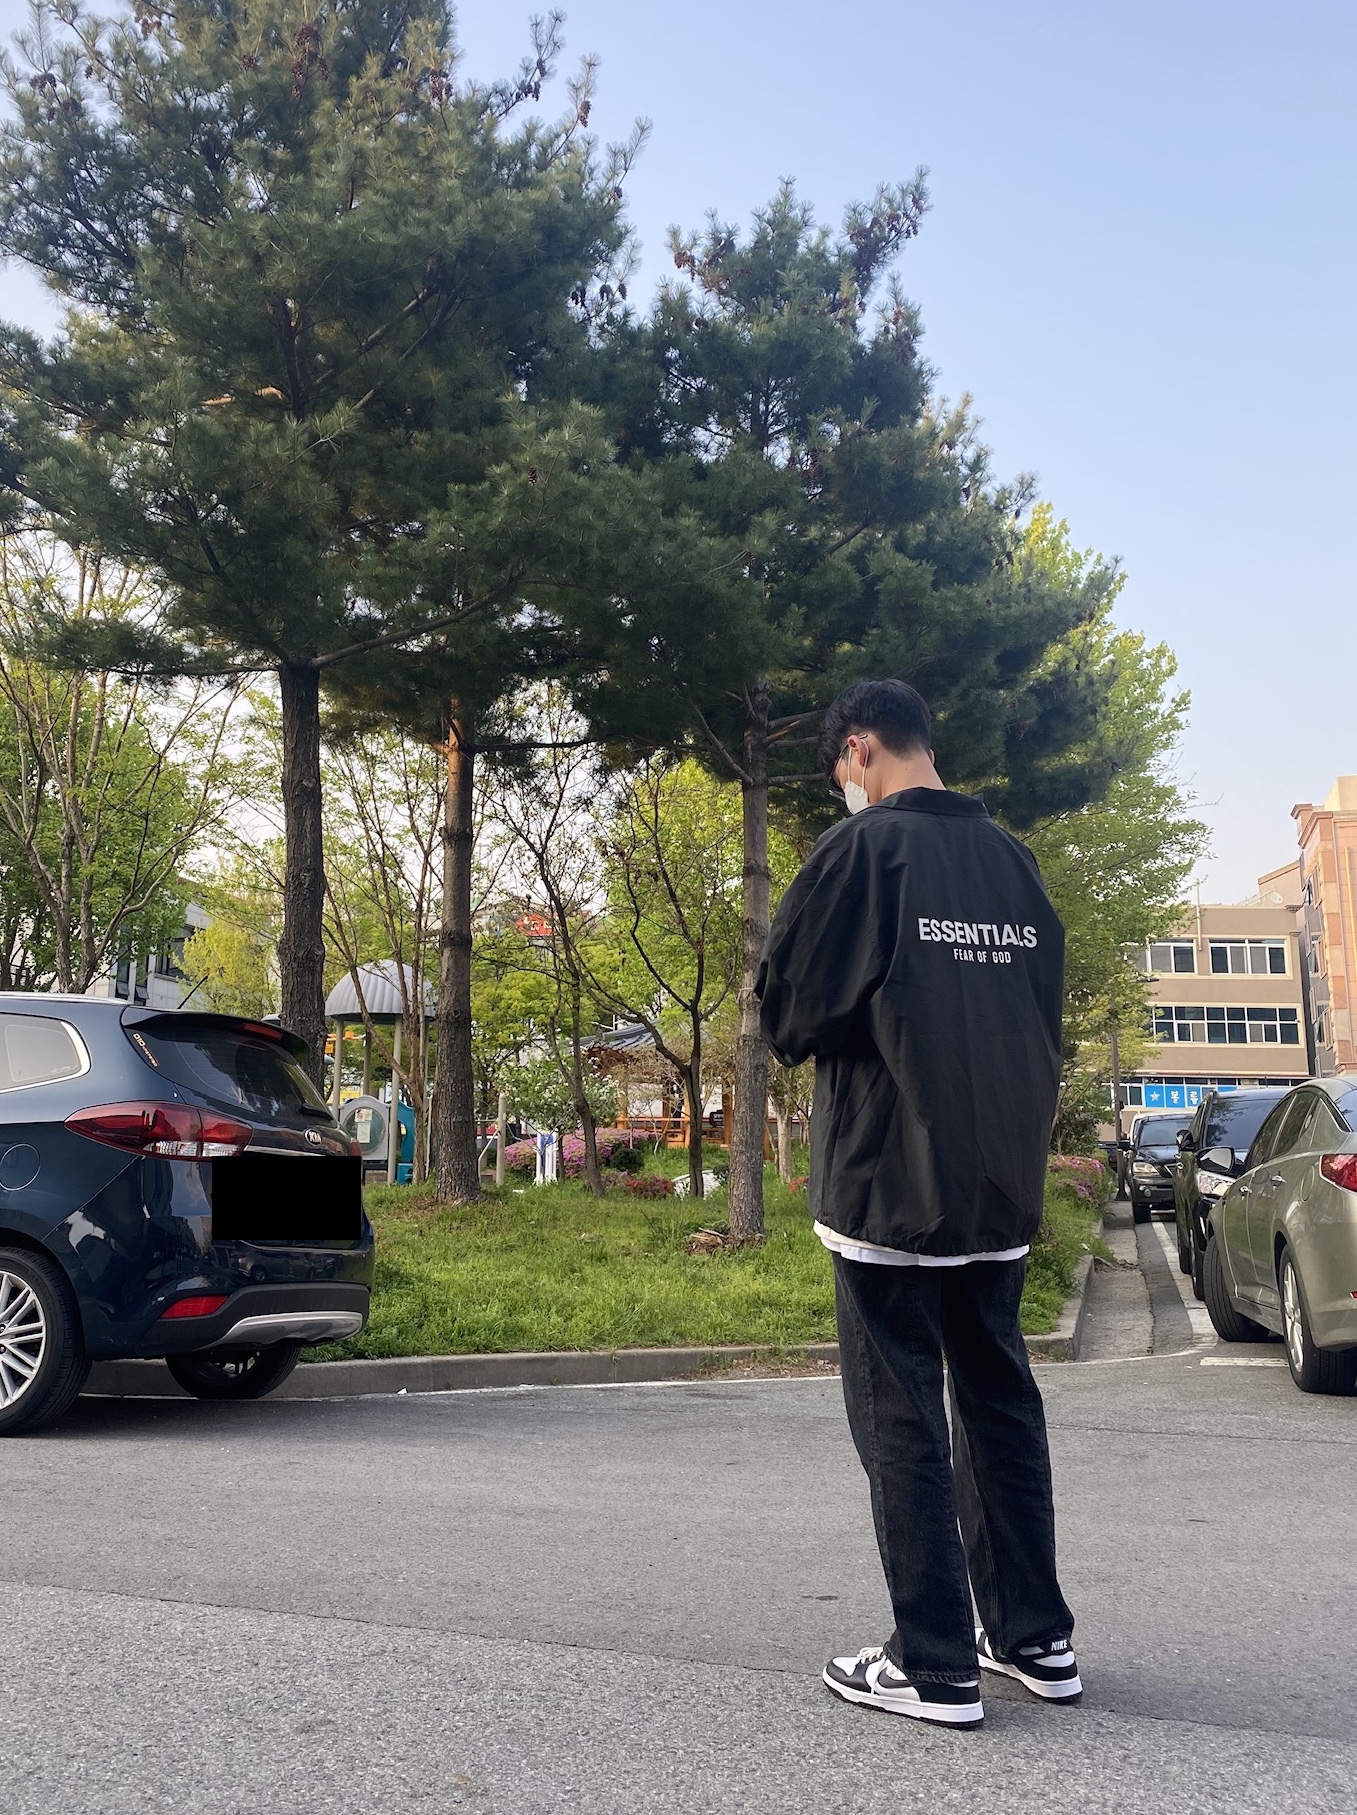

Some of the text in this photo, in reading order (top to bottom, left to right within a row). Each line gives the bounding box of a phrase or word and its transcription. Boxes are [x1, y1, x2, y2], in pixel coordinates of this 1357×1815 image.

[953, 949, 1012, 964] FEAR OF GOD
[307, 1130, 322, 1144] KIA
[1050, 1639, 1068, 1651] NIKE
